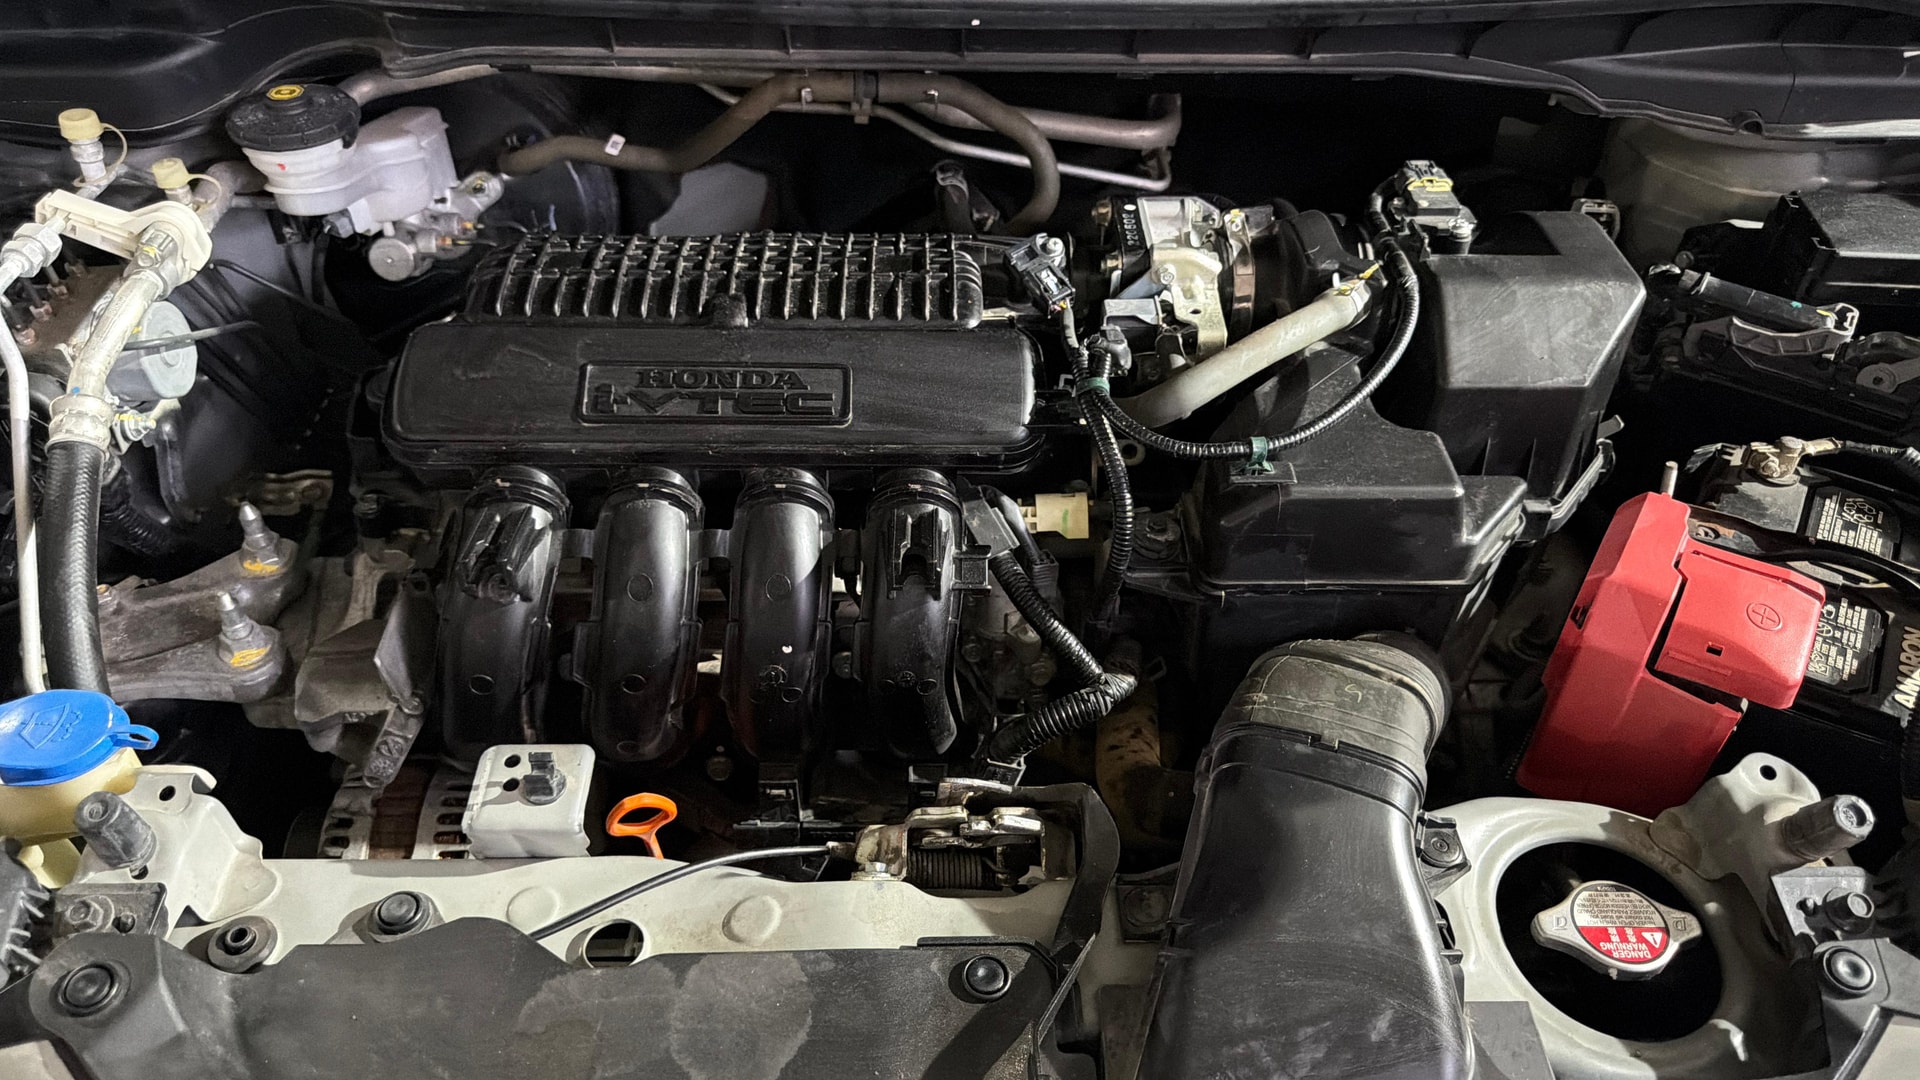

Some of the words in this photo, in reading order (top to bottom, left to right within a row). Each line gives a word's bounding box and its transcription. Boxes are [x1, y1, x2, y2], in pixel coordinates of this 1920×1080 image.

[635, 368, 810, 391] HONDA
[1894, 626, 1920, 709] AMARON
[1600, 942, 1648, 950] WARNUNG
[1613, 950, 1651, 958] DANGER
